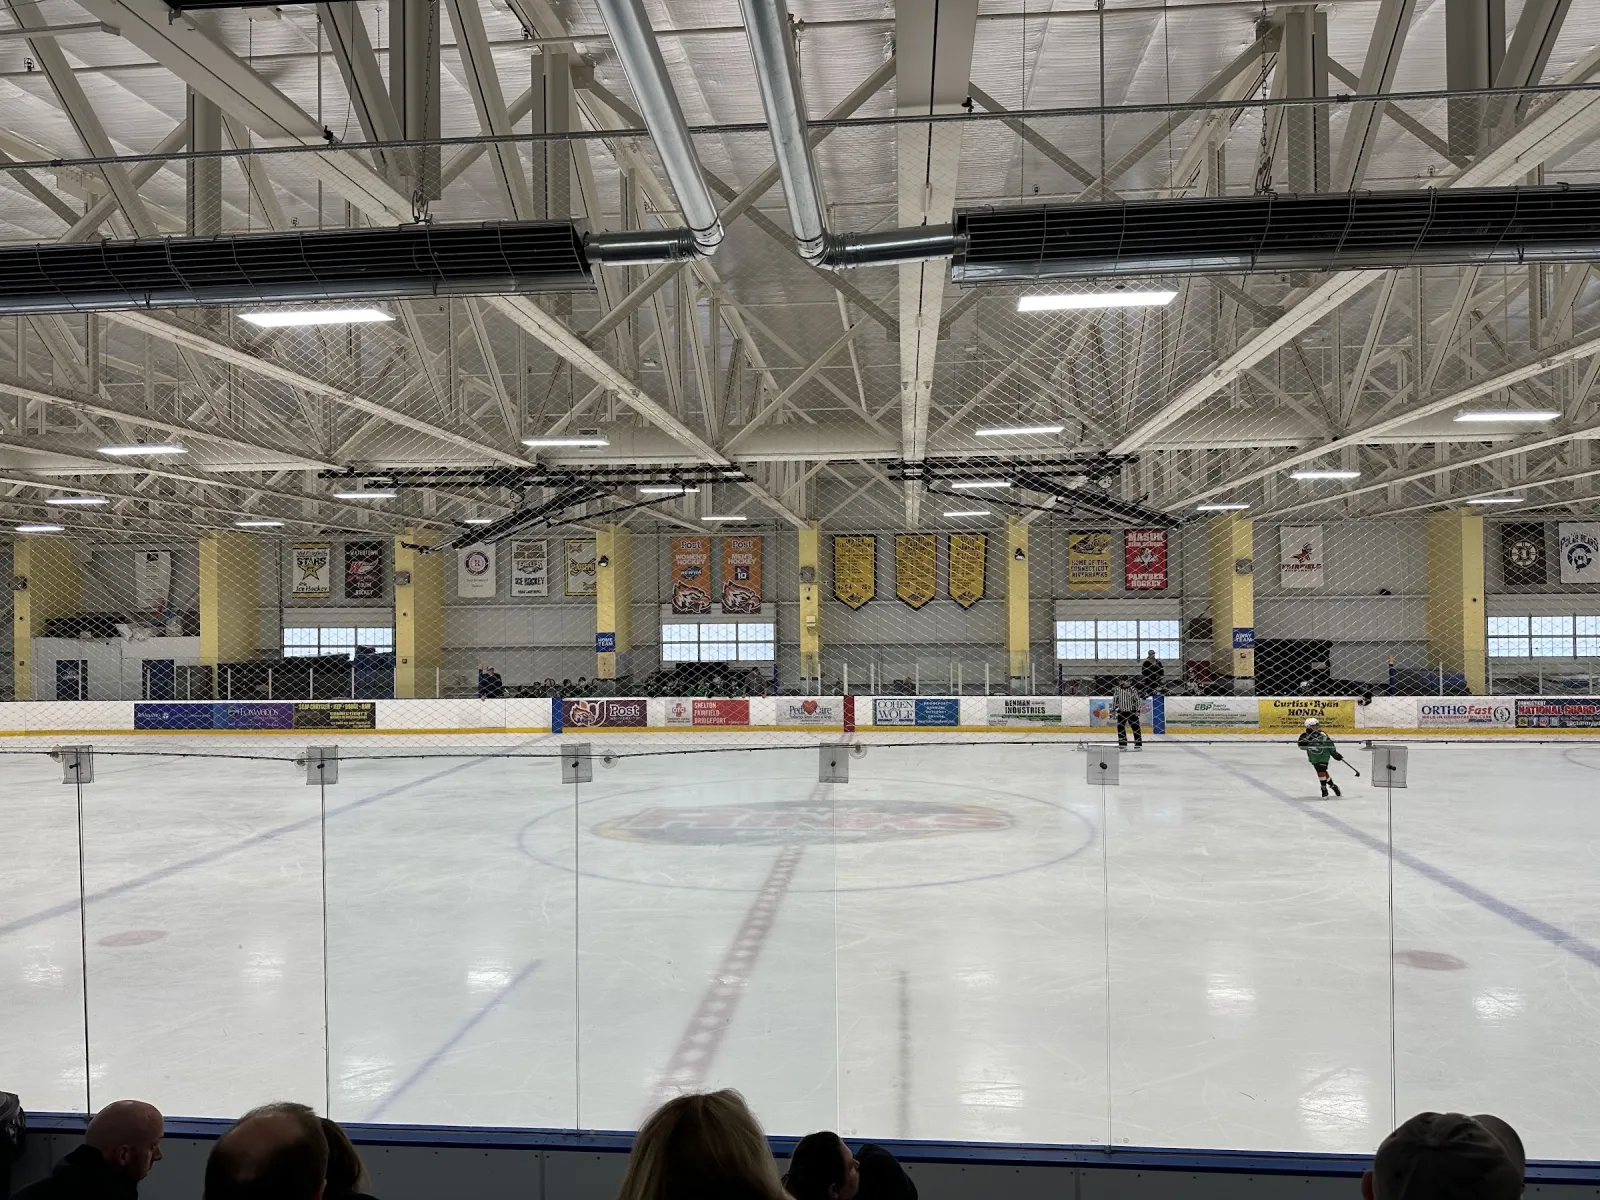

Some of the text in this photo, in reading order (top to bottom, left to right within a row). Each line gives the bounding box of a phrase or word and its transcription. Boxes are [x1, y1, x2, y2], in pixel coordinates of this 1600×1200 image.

[1128, 532, 1163, 541] MASUK
[681, 541, 702, 549] Post
[732, 540, 753, 549] Post
[297, 557, 327, 566] STARS
[1273, 700, 1339, 709] Curtiss Ryan
[609, 704, 640, 717] Post
[878, 710, 914, 719] WOLF
[1287, 708, 1325, 716] HONDA
[1518, 705, 1596, 715] NATIONAL GUARD
